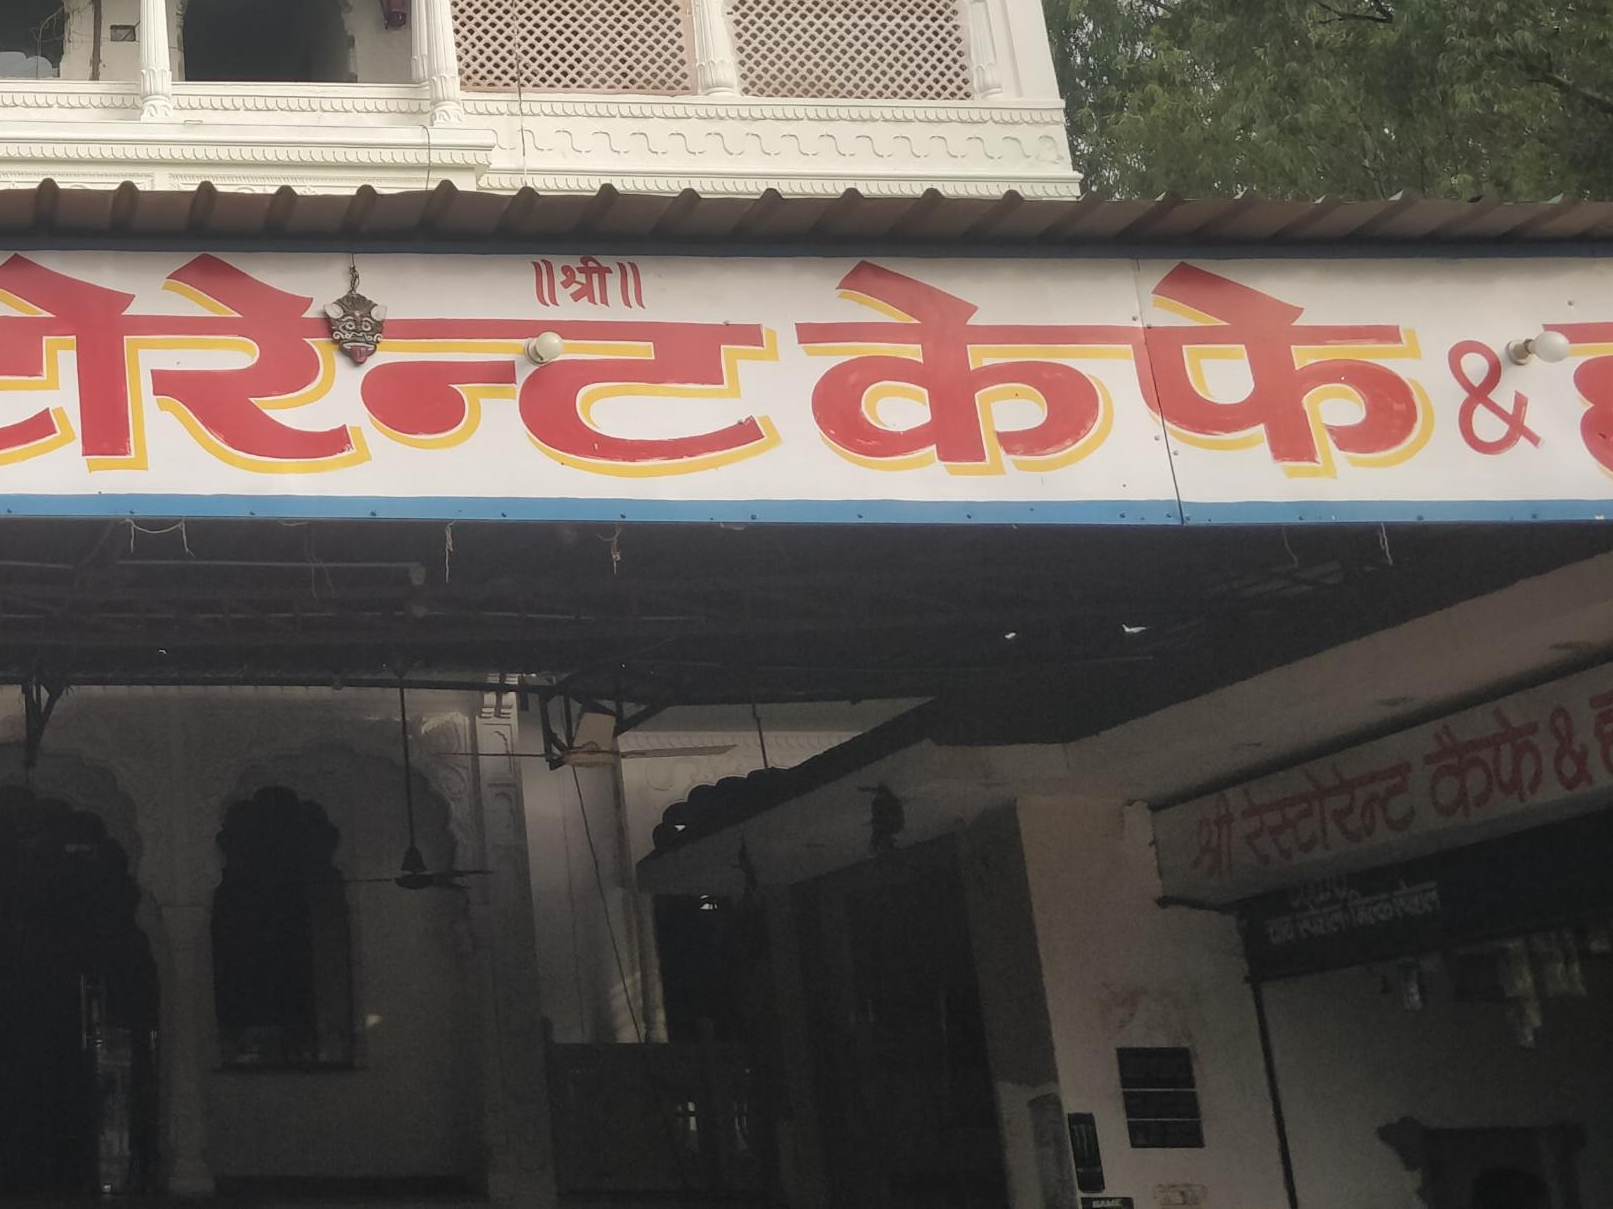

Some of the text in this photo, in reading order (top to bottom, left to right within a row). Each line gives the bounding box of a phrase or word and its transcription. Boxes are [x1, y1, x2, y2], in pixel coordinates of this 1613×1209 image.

[794, 260, 1434, 478] केफे
[1447, 339, 1543, 456] &
[1191, 792, 1235, 878] श्री
[1243, 763, 1416, 866] रेस्टोरेन्ट
[1424, 707, 1543, 819] कैफे
[1549, 705, 1594, 790] &
